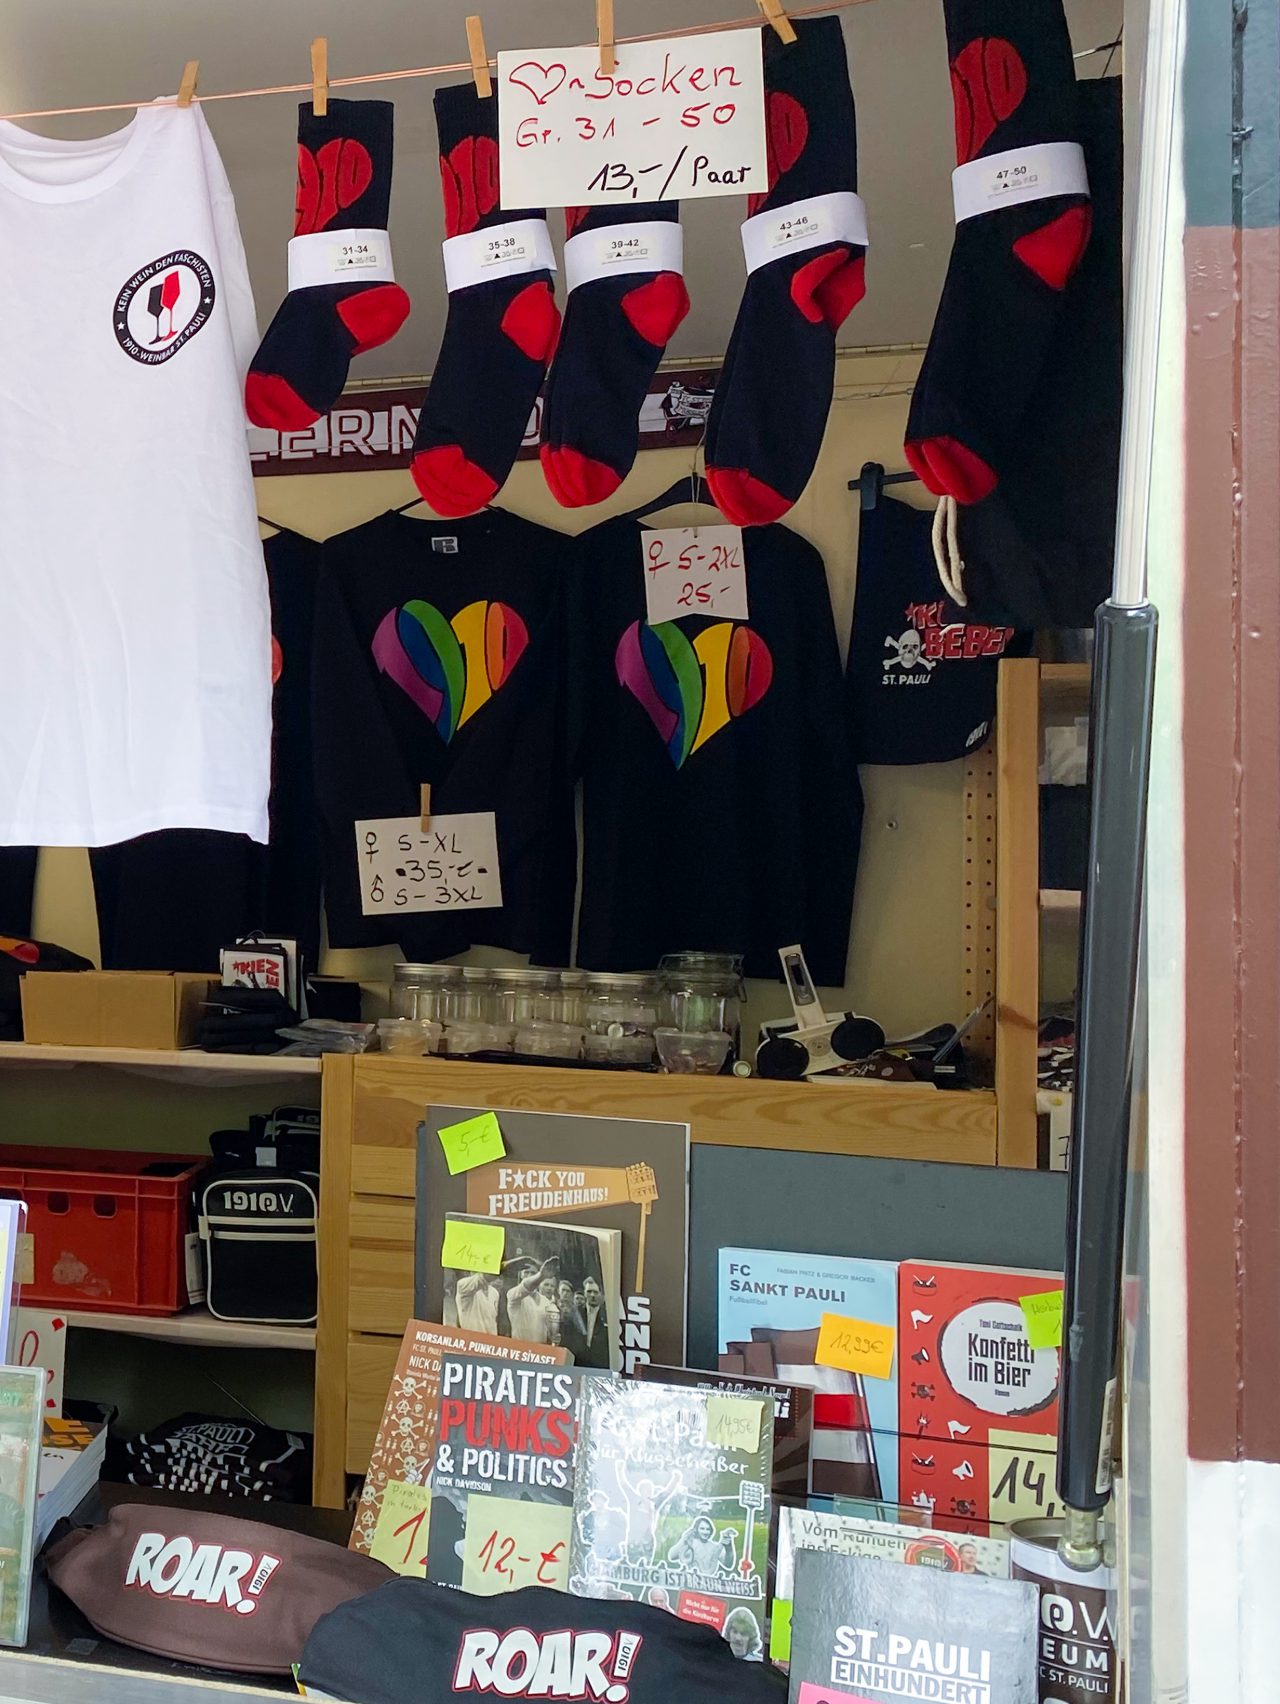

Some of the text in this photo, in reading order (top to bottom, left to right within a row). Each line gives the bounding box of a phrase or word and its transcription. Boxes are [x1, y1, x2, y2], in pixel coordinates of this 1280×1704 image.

[516, 102, 736, 148] Gr. 31 50
[996, 165, 1028, 180] 47-50
[779, 216, 810, 231] 43-46
[342, 245, 369, 255] 31-34
[488, 237, 516, 250] 35-38
[611, 238, 640, 250] 39-42
[117, 253, 212, 312] KEIN WEIN DEN FASCHISTEN
[184, 312, 206, 338] PAULI
[882, 674, 931, 685] ST. PAULI
[556, 1171, 585, 1188] YOU
[488, 1187, 609, 1216] FREUDENHAUS!
[729, 1263, 751, 1277] FC
[729, 1279, 846, 1303] SANKT PAULI
[415, 1331, 467, 1351] KORSANLAR,
[469, 1341, 508, 1359] PUNKLAR
[509, 1351, 521, 1361] VE
[968, 1332, 1035, 1364] Konfetti
[408, 1355, 430, 1370] NICK
[968, 1357, 1031, 1388] im Bier
[442, 1361, 573, 1410] PIRATES
[437, 1400, 573, 1458] PUNKS
[436, 1445, 569, 1489] & POLITICS
[436, 1476, 493, 1493] NICK DAVIDSON
[802, 1521, 838, 1539] Vom
[124, 1532, 280, 1614] ROAR!
[664, 1571, 682, 1587] IST
[686, 1574, 722, 1592] BRAUN
[723, 1579, 757, 1597] WEISS
[454, 1629, 642, 1702] ROAR!
[1043, 1641, 1109, 1673] EUM
[836, 1658, 988, 1704] EINHUNDERT
[1049, 1667, 1109, 1694] ST. PAULI
